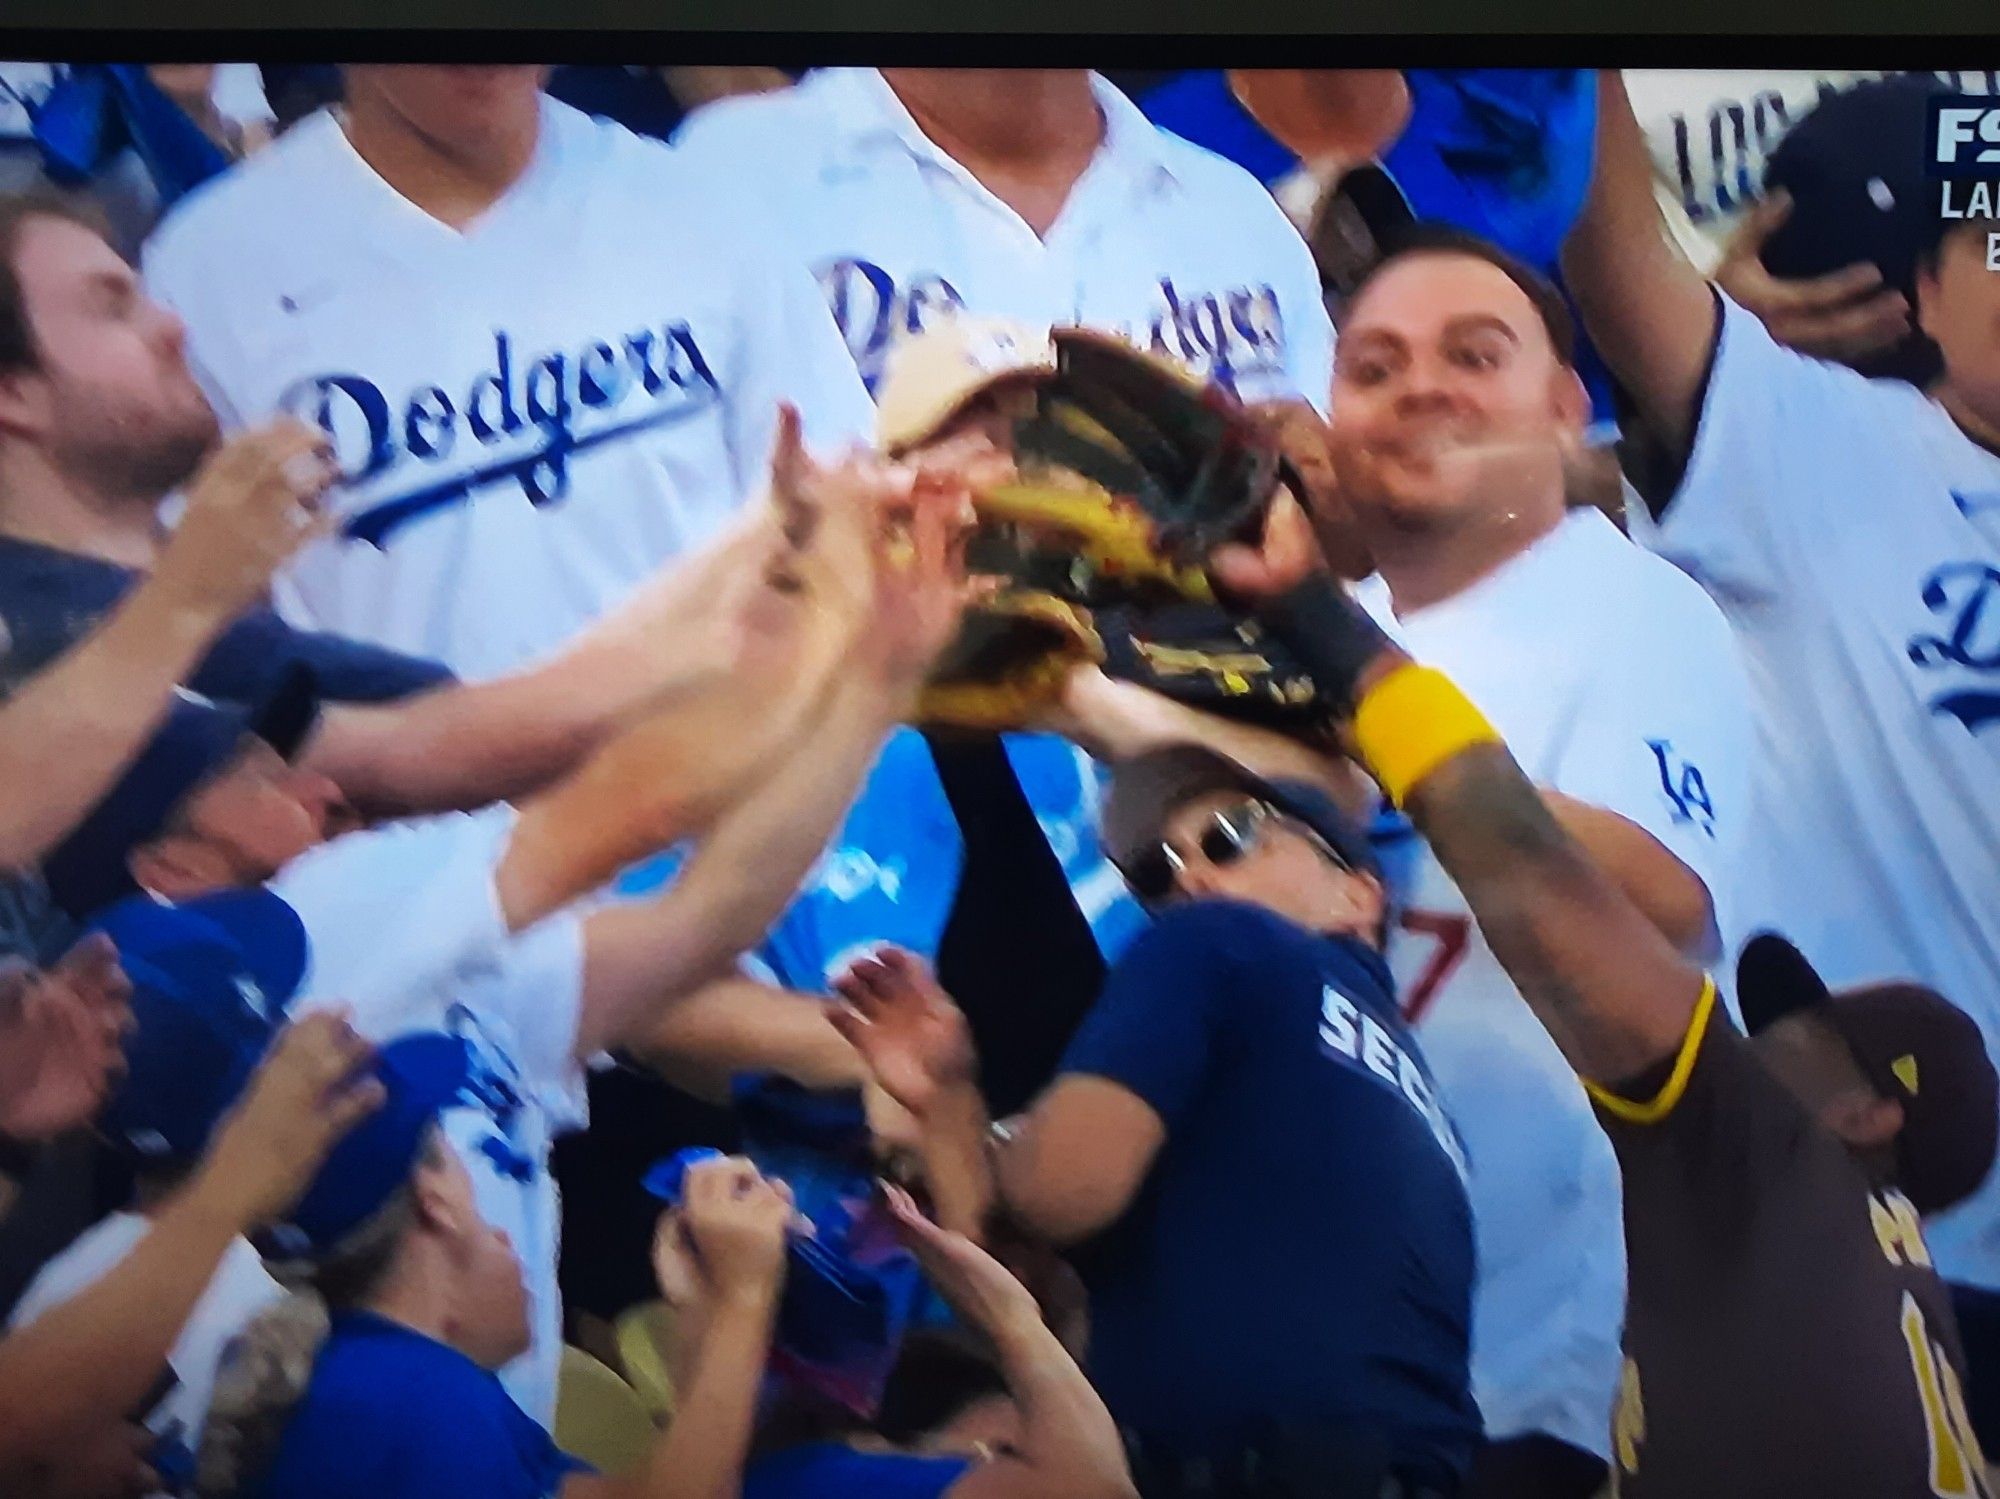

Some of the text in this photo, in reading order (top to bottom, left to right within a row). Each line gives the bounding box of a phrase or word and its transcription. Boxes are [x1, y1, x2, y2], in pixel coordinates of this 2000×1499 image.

[1940, 180, 2000, 219] LA
[284, 318, 722, 508] Dodgers
[1643, 736, 1716, 840] LA
[1400, 909, 1471, 1028] 7
